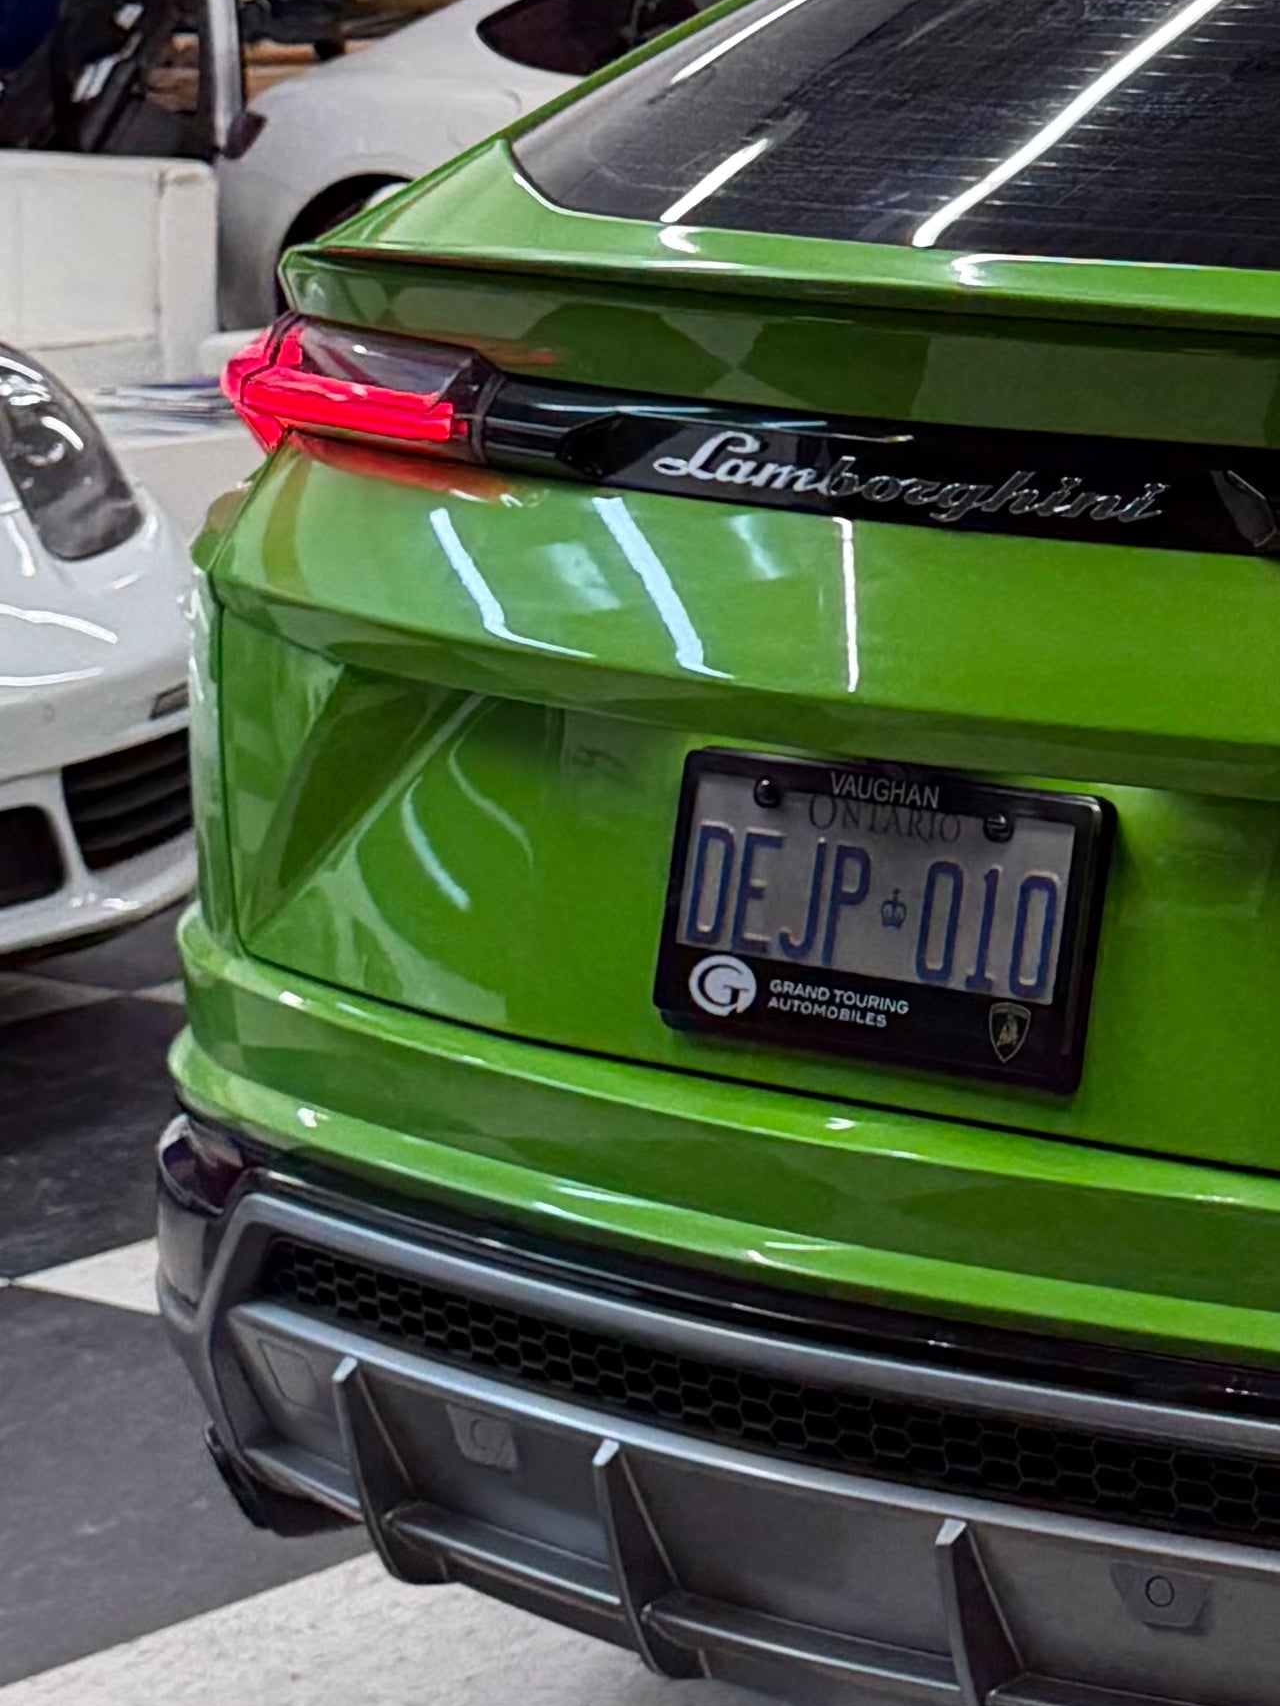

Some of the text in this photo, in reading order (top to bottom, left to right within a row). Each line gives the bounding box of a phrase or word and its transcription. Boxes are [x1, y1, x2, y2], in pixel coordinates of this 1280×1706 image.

[653, 431, 1169, 523] Lamborghini
[830, 771, 940, 809] VAUGHAN
[808, 795, 962, 844] ONTARIO
[684, 820, 1060, 999] DEJP 010
[767, 996, 888, 1028] AUTOMOBILES
[769, 978, 910, 1015] GRAND TOURING
